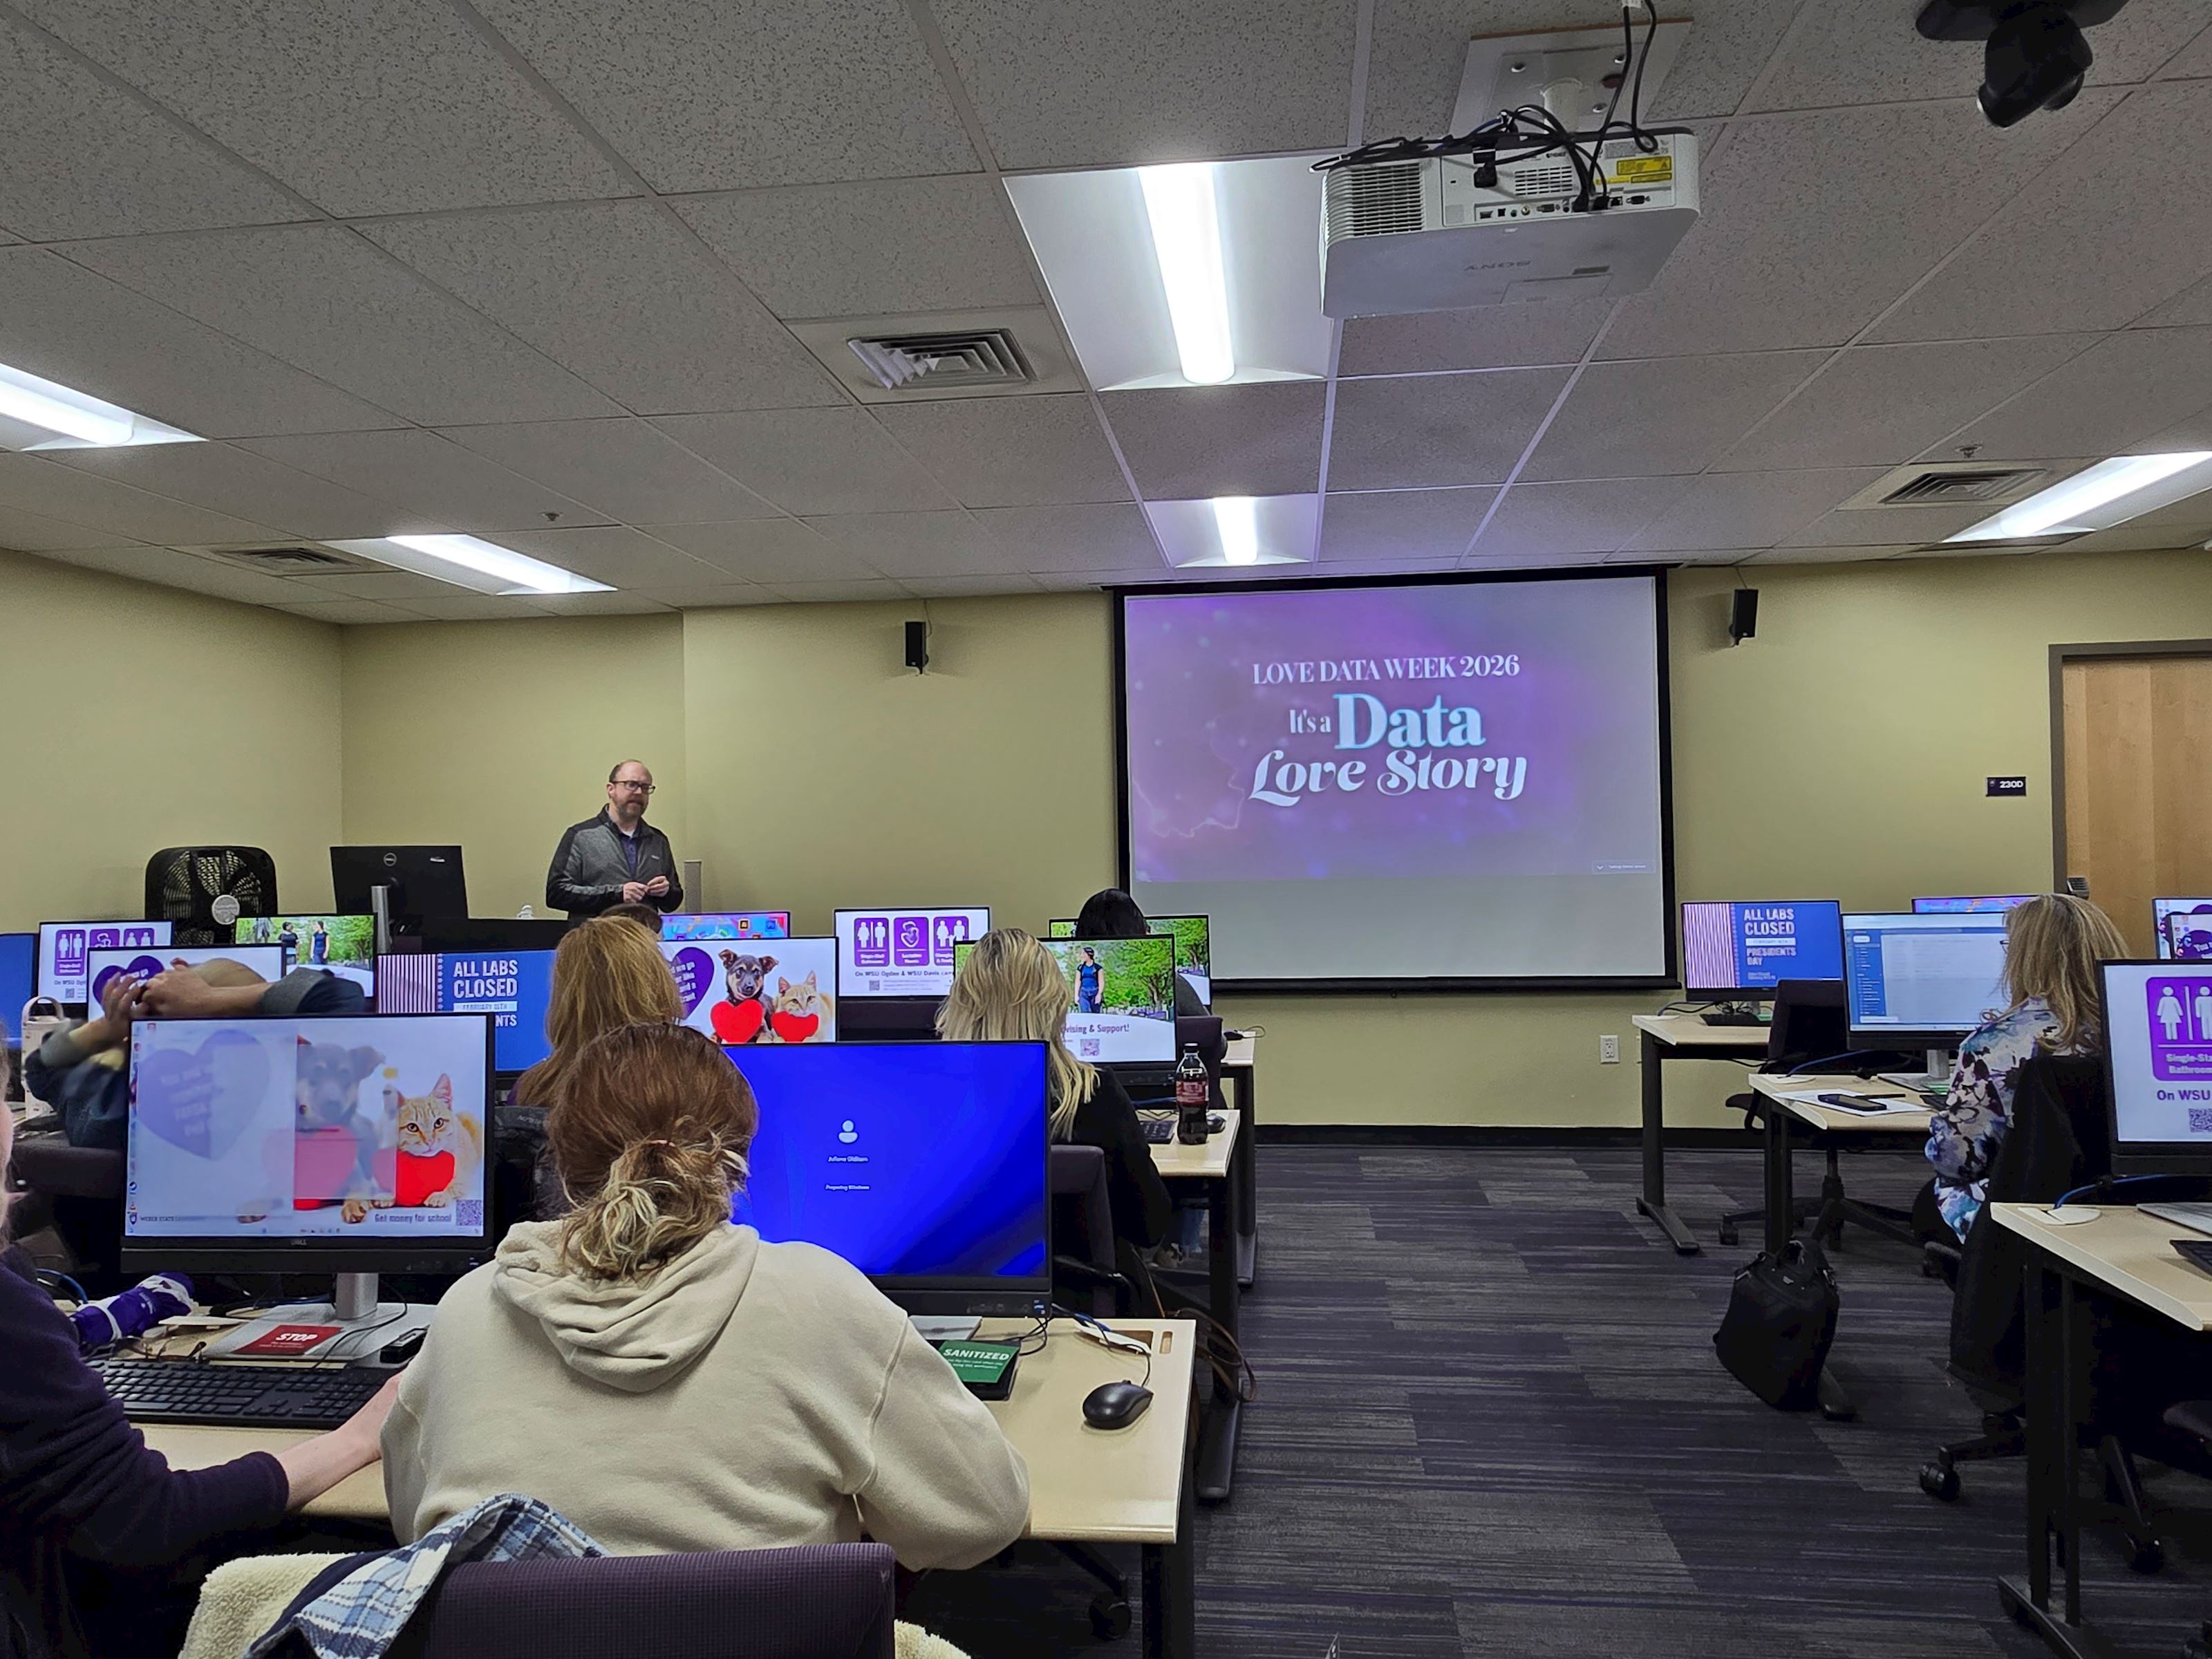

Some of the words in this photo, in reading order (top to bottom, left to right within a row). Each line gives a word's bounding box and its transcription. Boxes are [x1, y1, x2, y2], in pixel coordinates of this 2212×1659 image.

[1253, 662, 1314, 685] LOVE
[1320, 659, 1381, 682] DATA
[1384, 656, 1456, 679] WEEK
[1459, 654, 1520, 678] 2026
[1289, 709, 1316, 733] It's
[1320, 717, 1331, 733] a
[1333, 692, 1486, 750] Data
[1247, 749, 1367, 807] Love
[1376, 749, 1527, 800] Story
[1999, 780, 2024, 789] 230D
[1744, 909, 1764, 921] ALL
[1766, 908, 1794, 920] LABS
[1745, 921, 1795, 935] CLOSED
[1746, 947, 1797, 957] PRESIDENTS
[1747, 956, 1763, 966] DAY
[453, 962, 479, 977] ALL
[482, 959, 518, 976] LABS
[453, 978, 518, 998] CLOSED
[1089, 1024, 1095, 1033] &
[1097, 1024, 1130, 1034] Support!
[2157, 1090, 2175, 1100] On
[2177, 1089, 2211, 1100] WSU
[375, 1214, 387, 1223] Get
[389, 1215, 413, 1224] money
[415, 1214, 425, 1223] for
[428, 1214, 452, 1223] school
[275, 1333, 318, 1342] STOP
[943, 1348, 1010, 1360] SANITIZED
